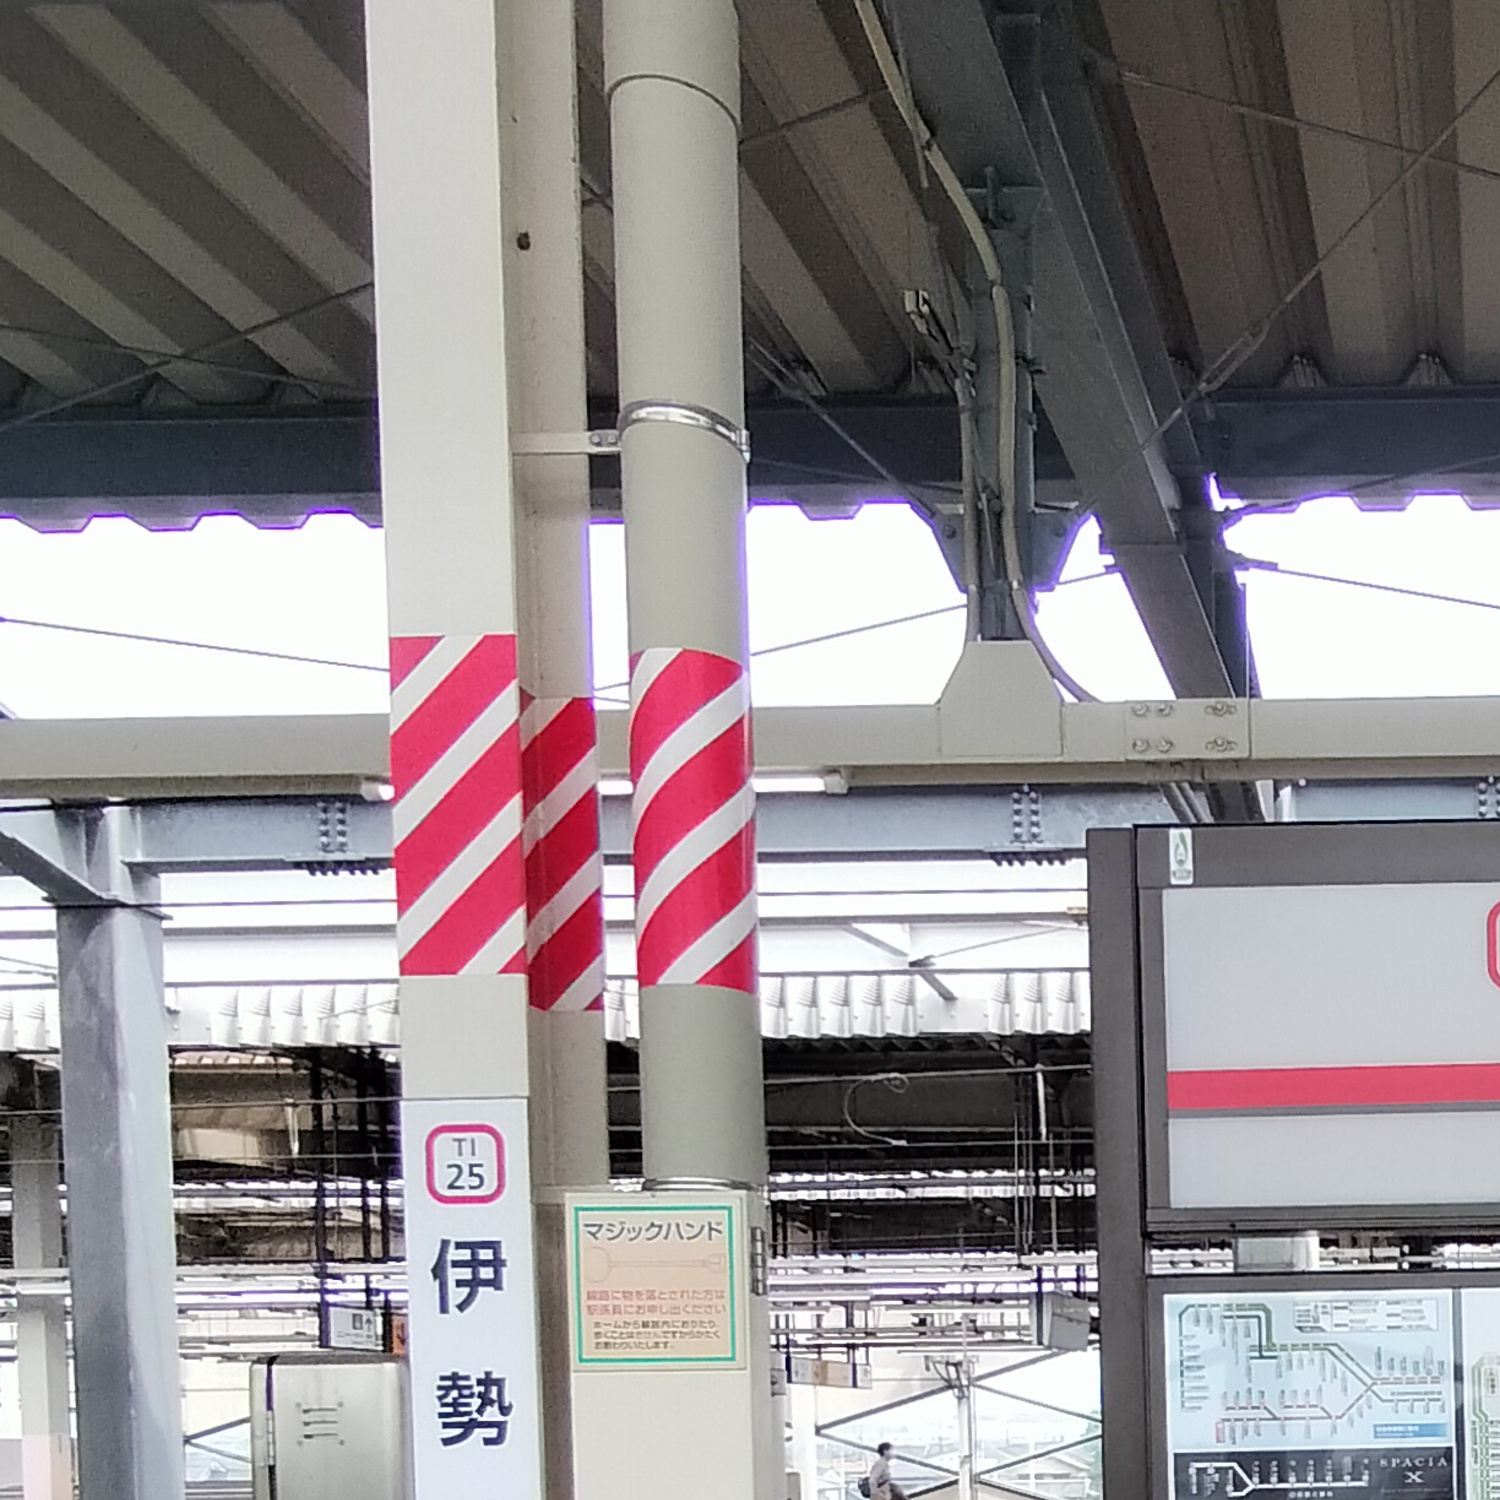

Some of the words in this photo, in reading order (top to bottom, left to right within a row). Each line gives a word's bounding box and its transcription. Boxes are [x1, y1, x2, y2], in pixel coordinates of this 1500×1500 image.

[452, 1138, 475, 1156] TI
[447, 1163, 484, 1190] 25
[583, 1221, 723, 1242] マジックハンド
[1379, 1456, 1448, 1468] SPACIA
[1404, 1471, 1425, 1483] X
